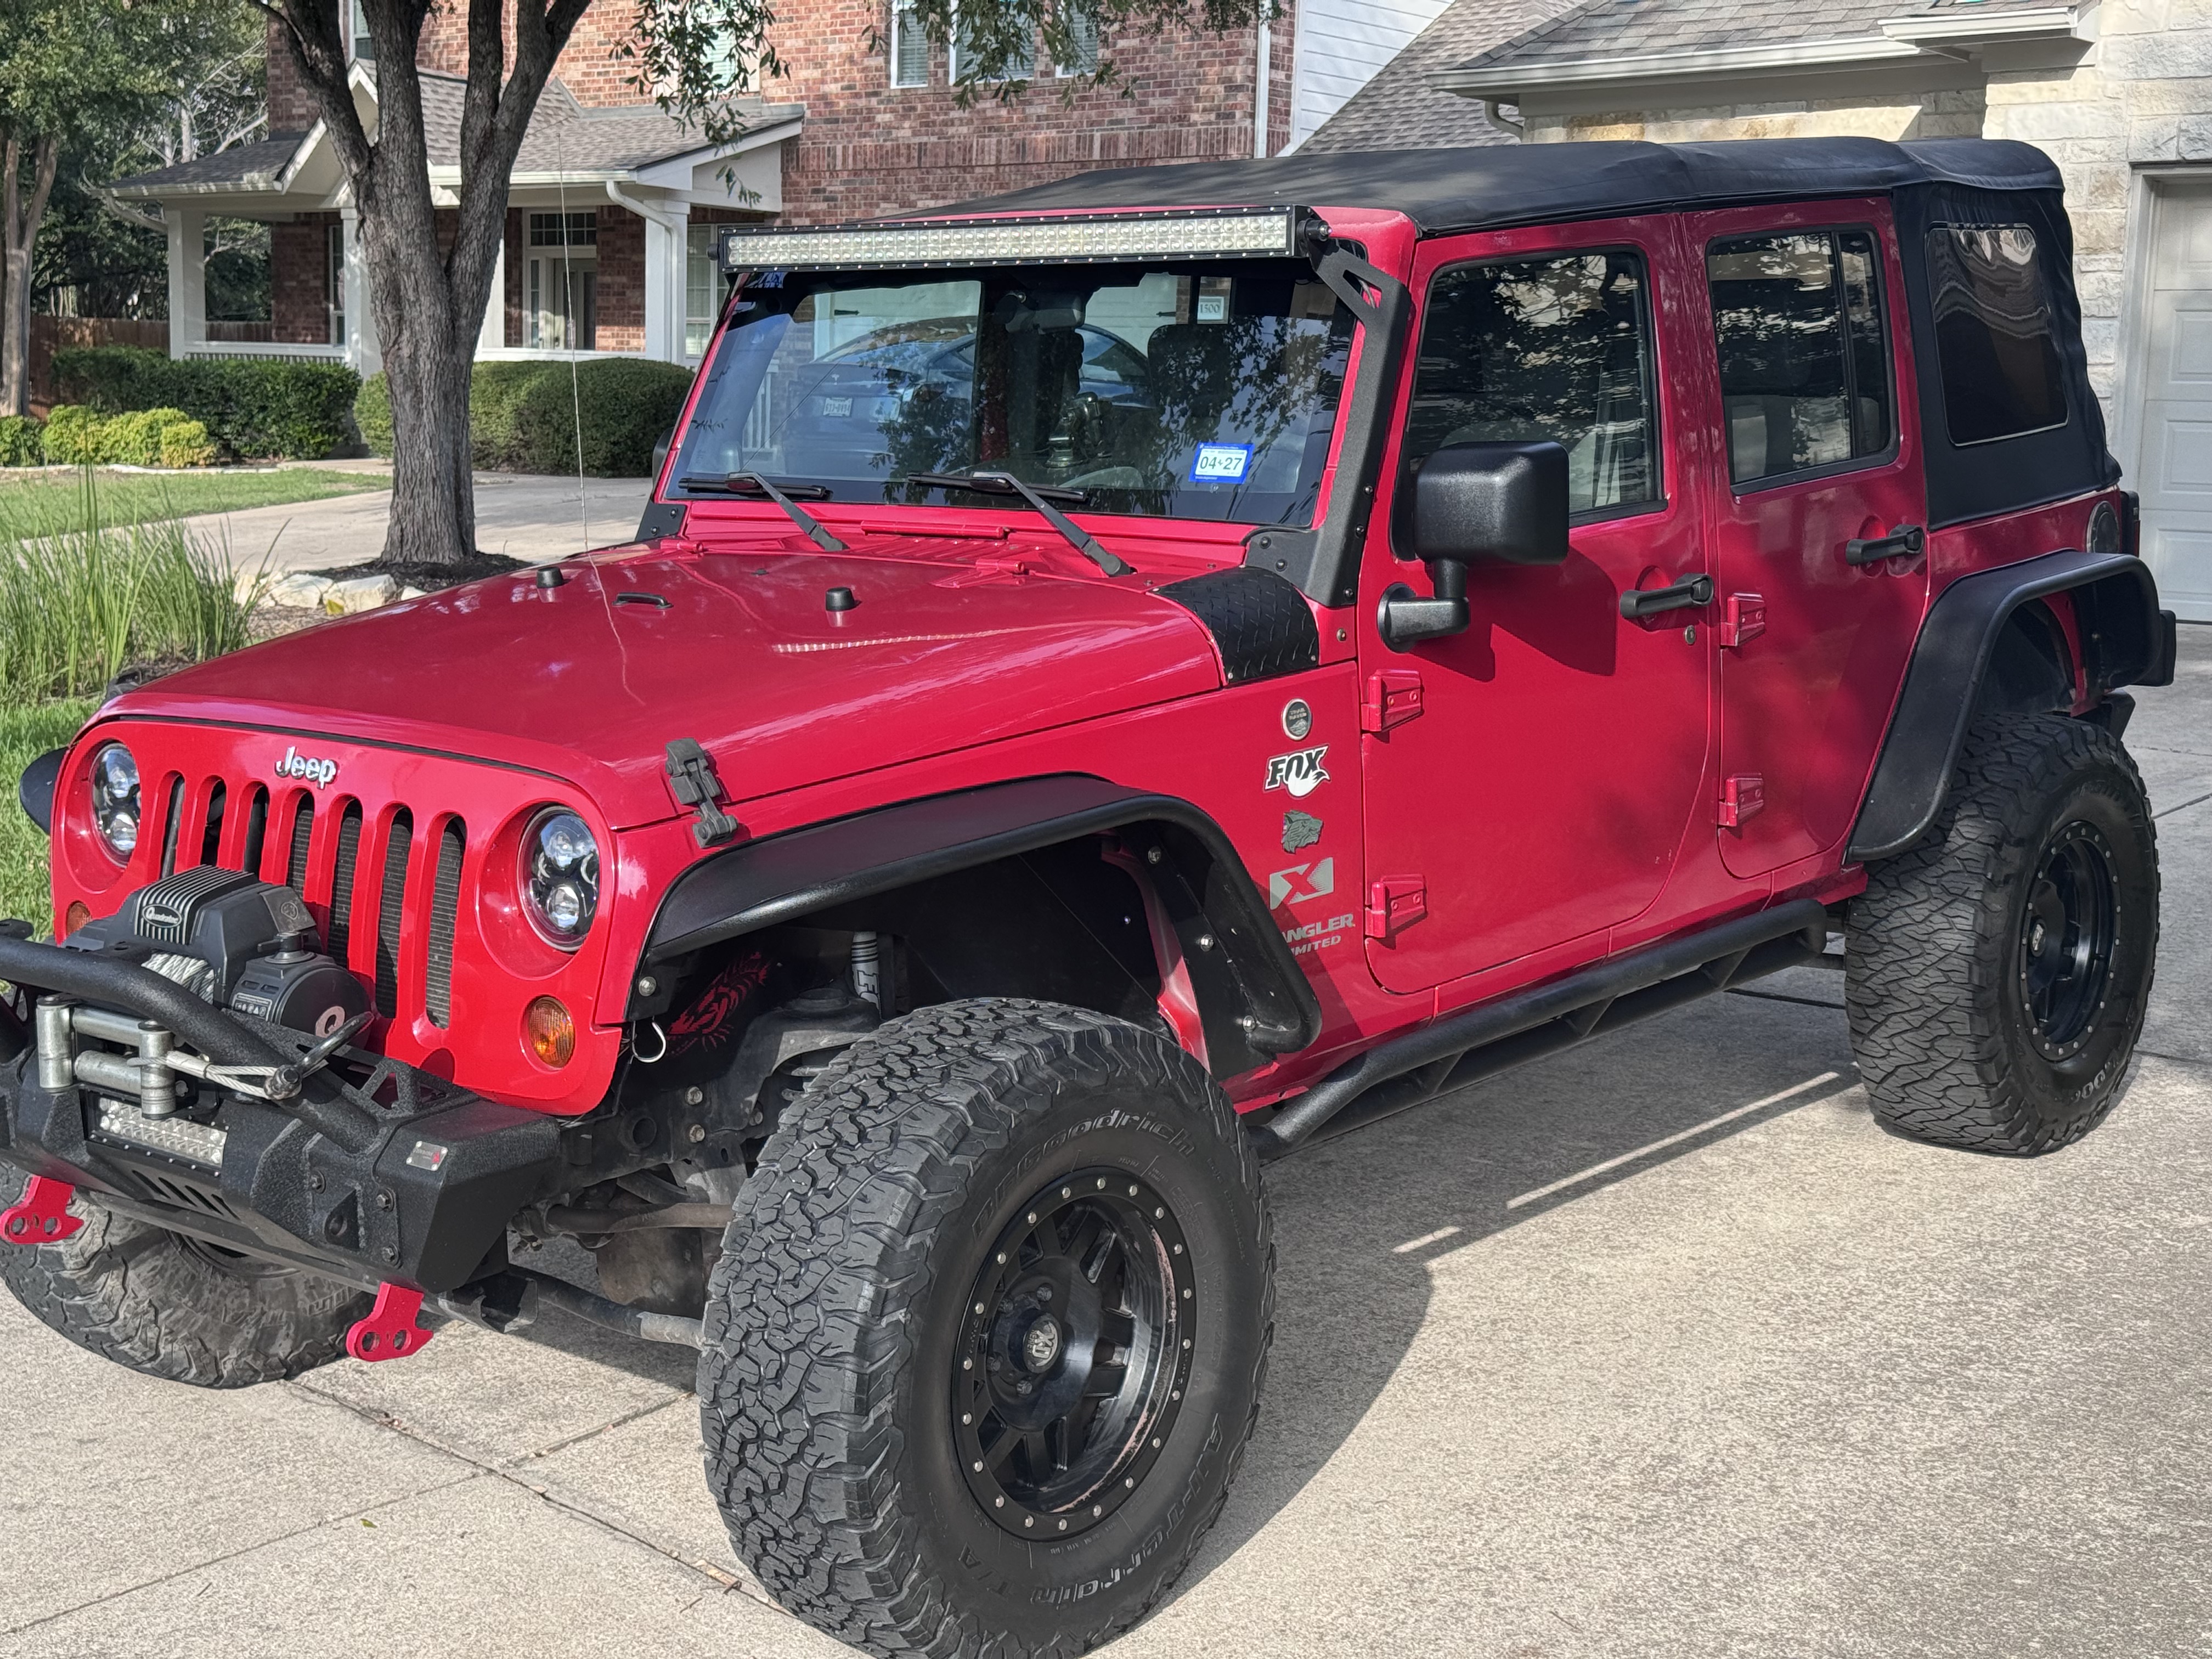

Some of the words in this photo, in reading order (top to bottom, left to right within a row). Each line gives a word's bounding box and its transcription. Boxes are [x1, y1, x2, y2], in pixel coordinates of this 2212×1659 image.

[1200, 303, 1220, 314] 1500
[1200, 456, 1217, 469] 04
[1223, 457, 1243, 470] 27
[275, 746, 337, 790] Jeep
[1265, 746, 1328, 790] FOX
[145, 906, 179, 924] Quadratec
[972, 1107, 1196, 1243] BFGoodrich
